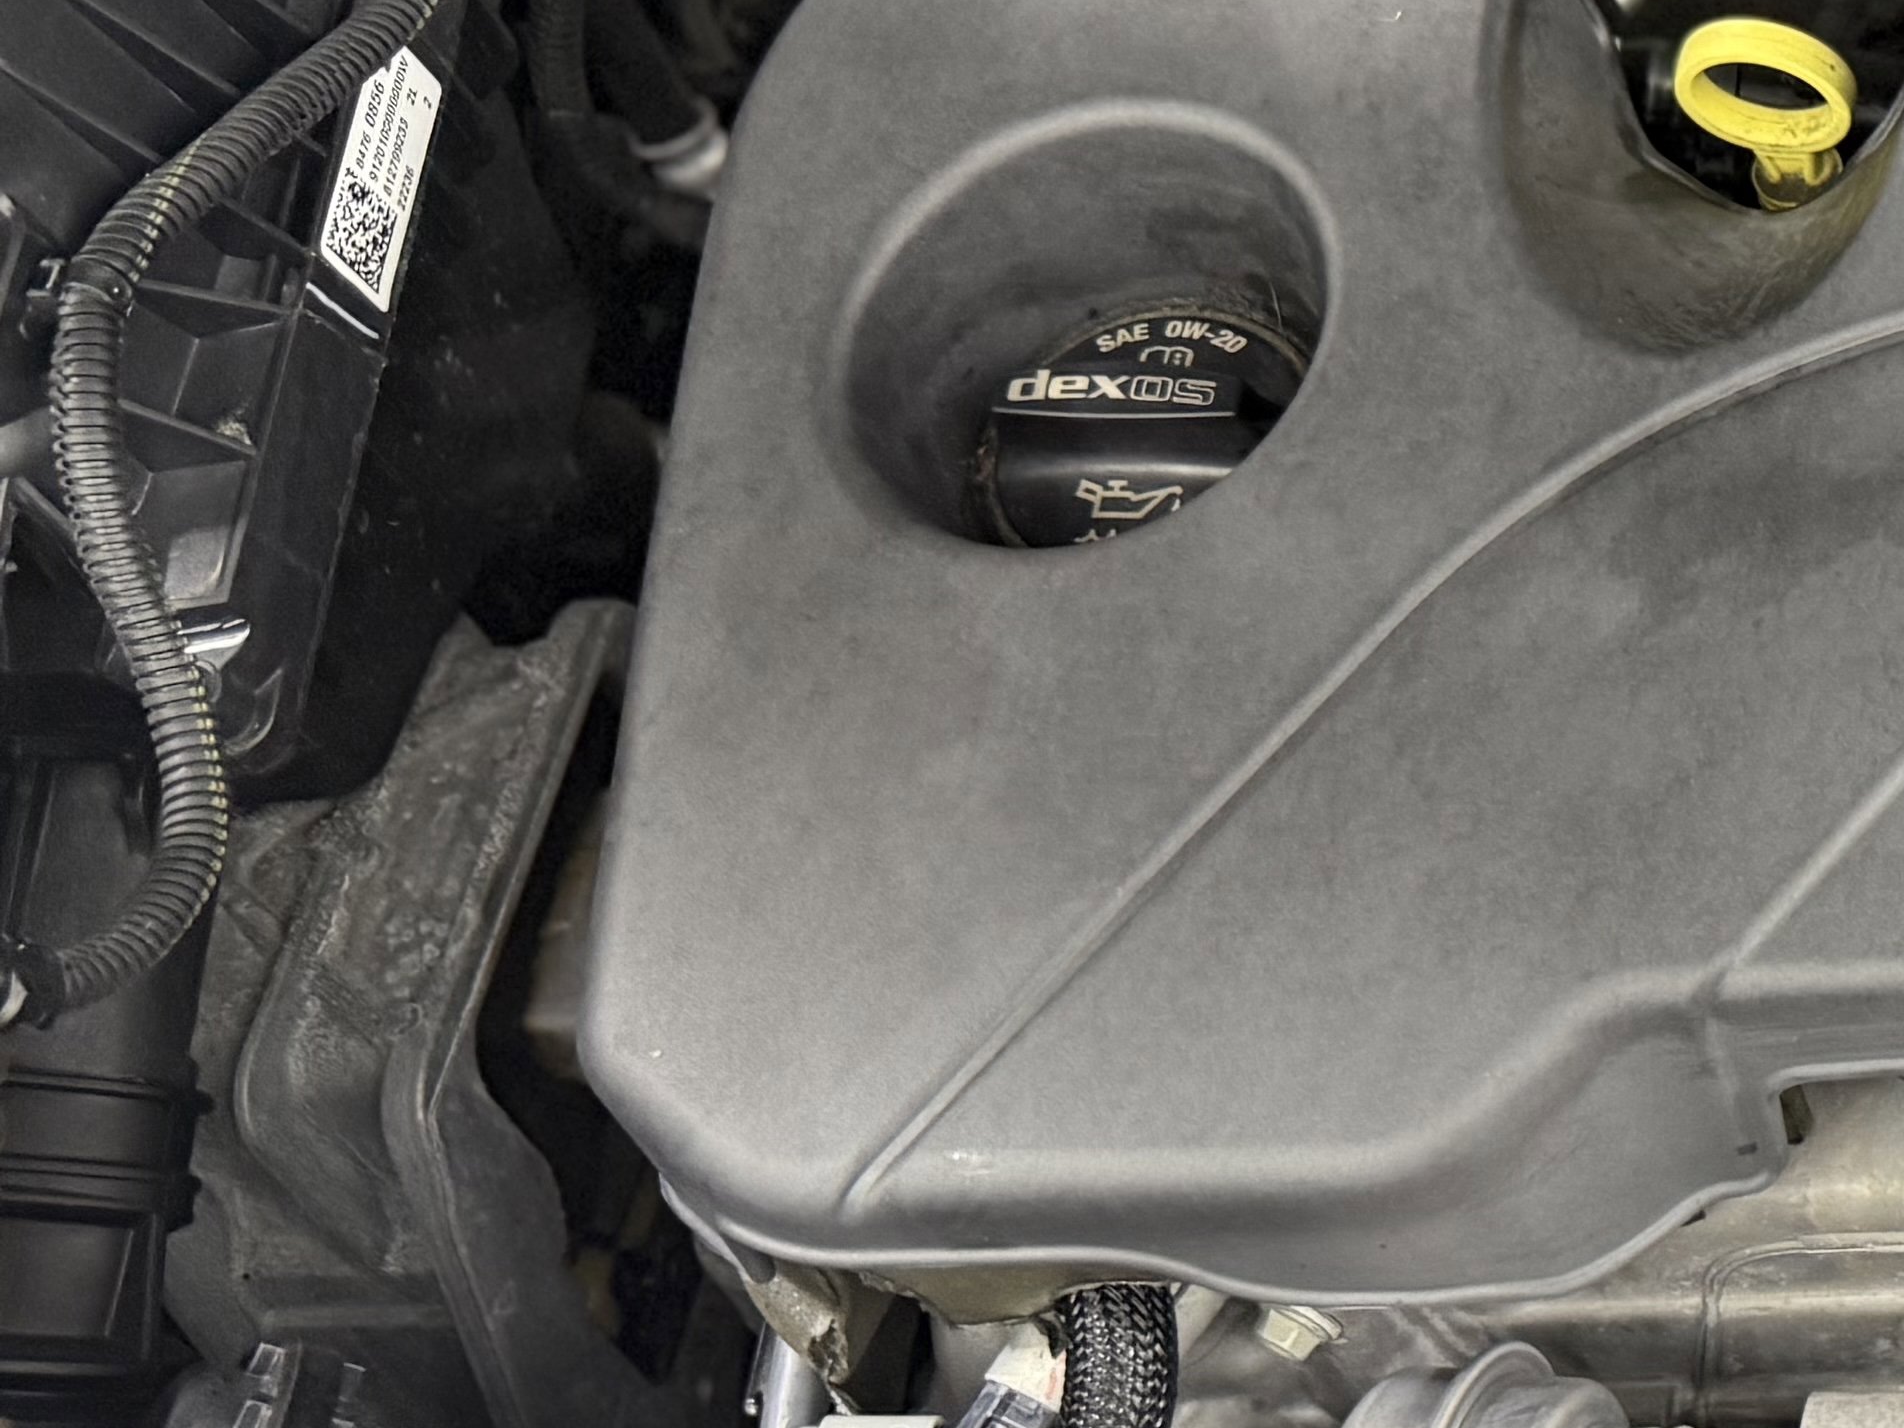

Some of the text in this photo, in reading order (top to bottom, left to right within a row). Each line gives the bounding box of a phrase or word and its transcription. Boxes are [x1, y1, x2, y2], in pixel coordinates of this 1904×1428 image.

[365, 78, 383, 127] 0856
[1096, 320, 1249, 355] SAE 0W-20
[1006, 368, 1217, 406] dexos
